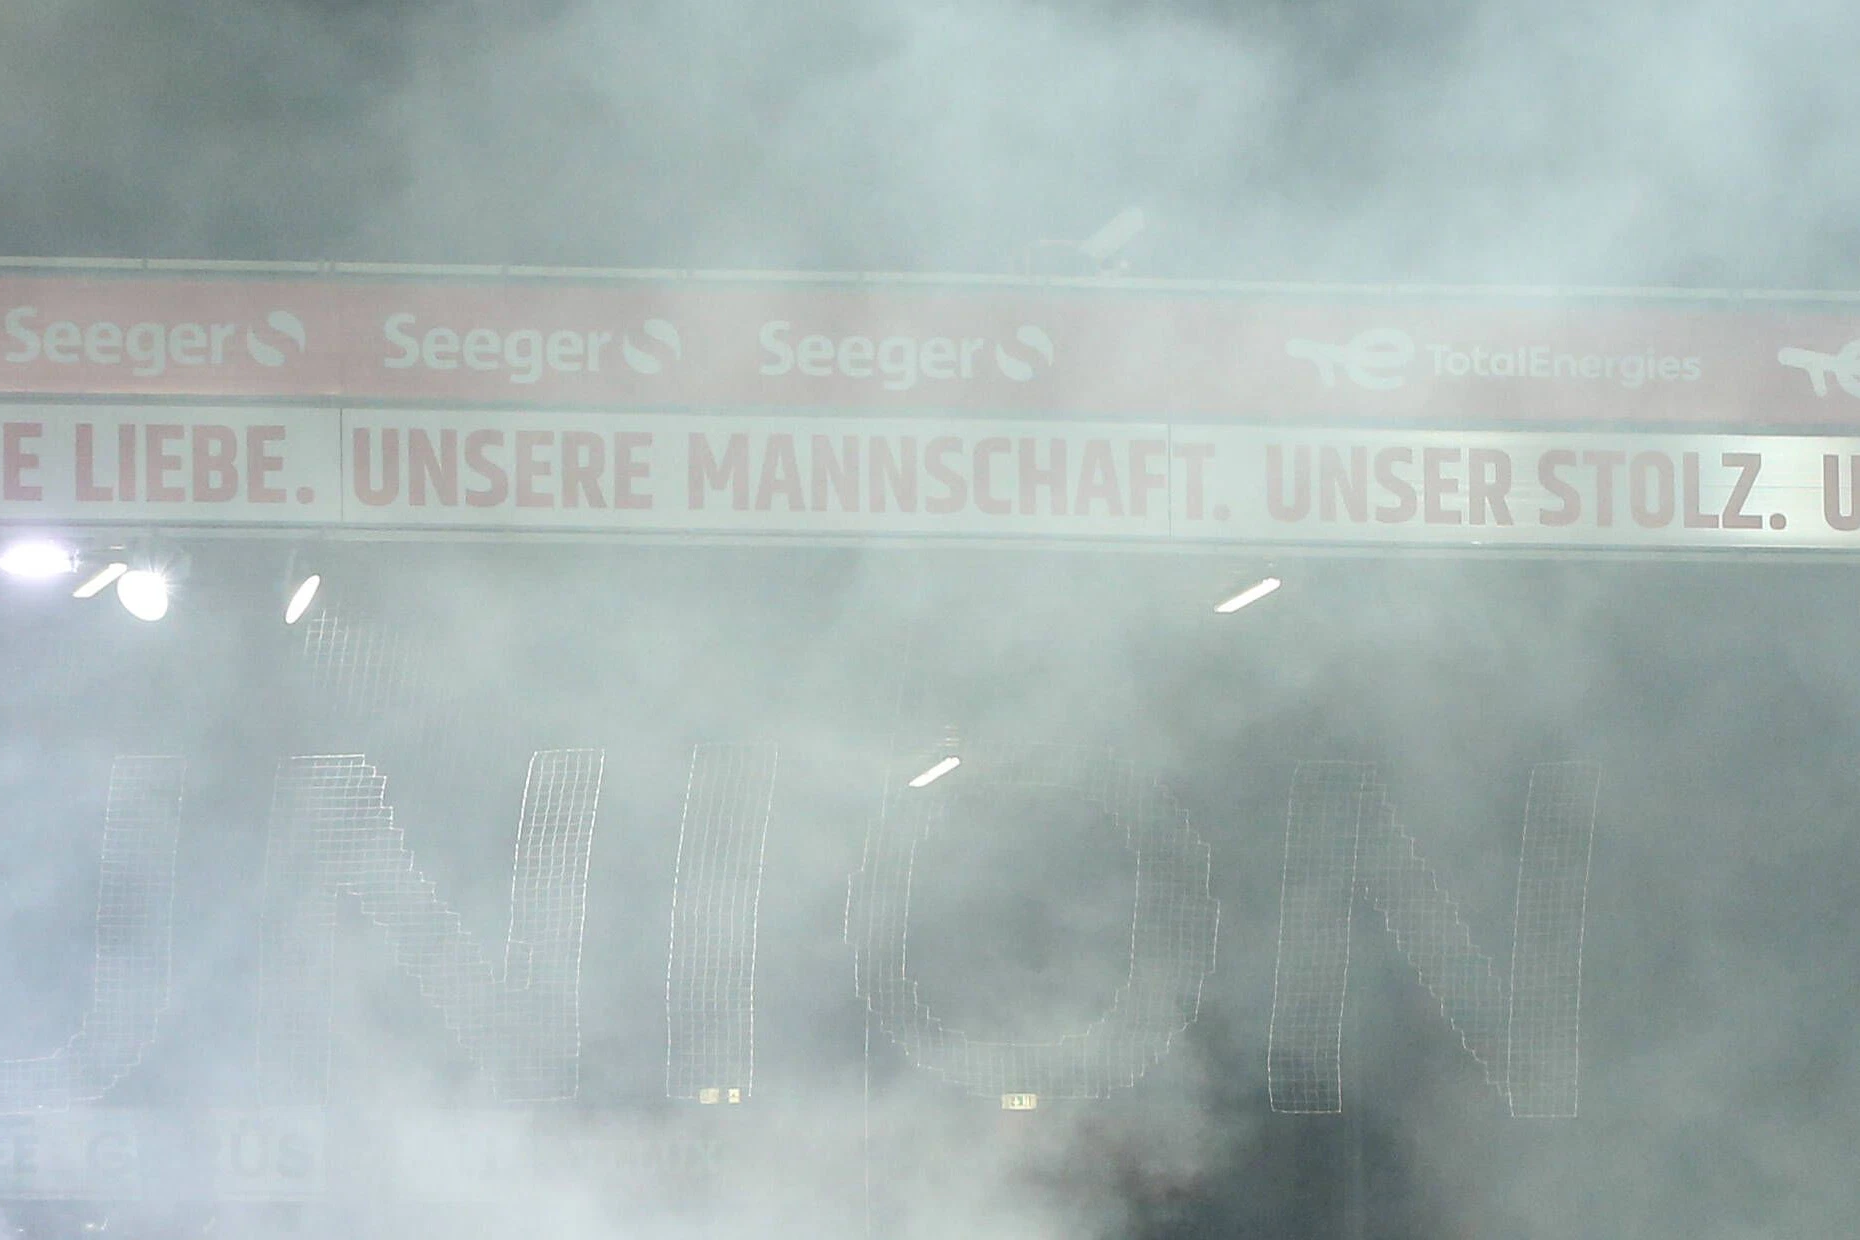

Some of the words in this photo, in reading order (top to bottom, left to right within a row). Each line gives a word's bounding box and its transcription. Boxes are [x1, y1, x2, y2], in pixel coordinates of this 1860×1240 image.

[4, 307, 235, 377] Seeger
[384, 312, 611, 385] Seeger
[759, 320, 983, 392] Seeger
[1426, 343, 1702, 388] TotalEnergies
[74, 422, 316, 505] LIEBE.
[352, 427, 654, 510] UNSERE
[687, 431, 1231, 522] MANNSCHAFT.
[1265, 443, 1514, 526] UNSER
[1537, 449, 1787, 531] STOLZ.
